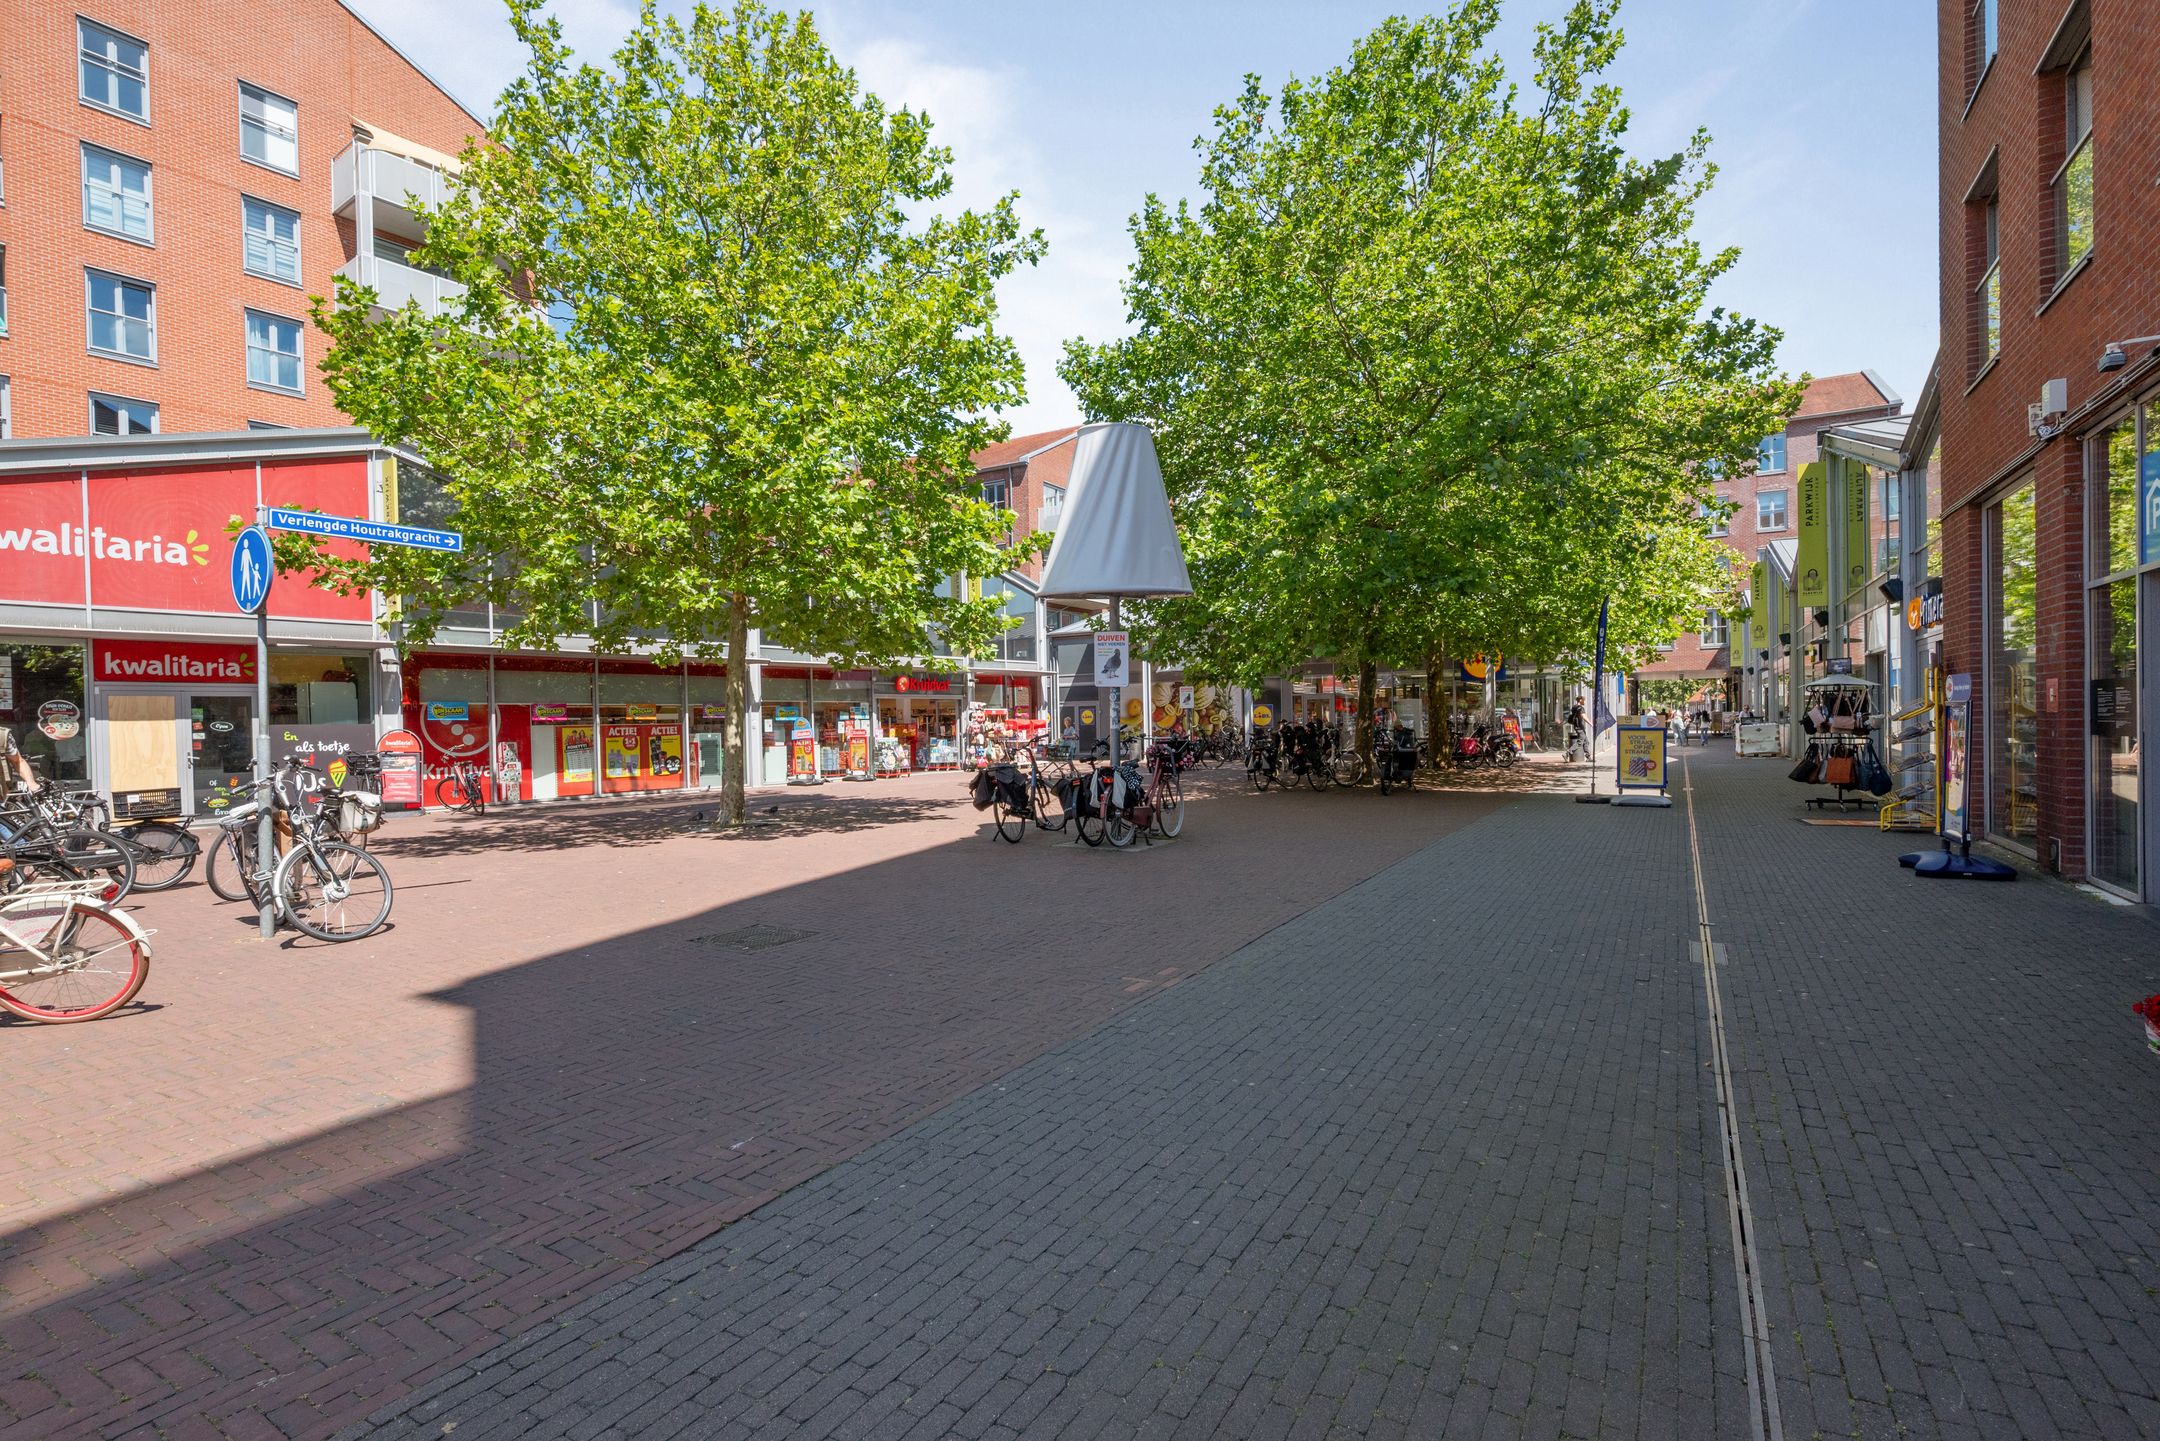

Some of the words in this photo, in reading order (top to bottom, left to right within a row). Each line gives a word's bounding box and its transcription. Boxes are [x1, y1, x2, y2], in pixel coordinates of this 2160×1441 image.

[1805, 477, 1814, 527] PARKWIJK
[278, 513, 348, 533] Verlengde
[350, 523, 441, 544] Houtrakgracht
[0, 522, 189, 566] walitaria
[1097, 634, 1126, 642] DUIVEN
[104, 651, 241, 678] kwalitaria
[909, 676, 951, 692] Kruidvat
[284, 731, 299, 741] En
[608, 727, 637, 736] ACTIE!
[651, 726, 678, 735] ACTIE!
[295, 741, 315, 752] als
[317, 740, 350, 755] toetje
[666, 760, 680, 768] 2+2
